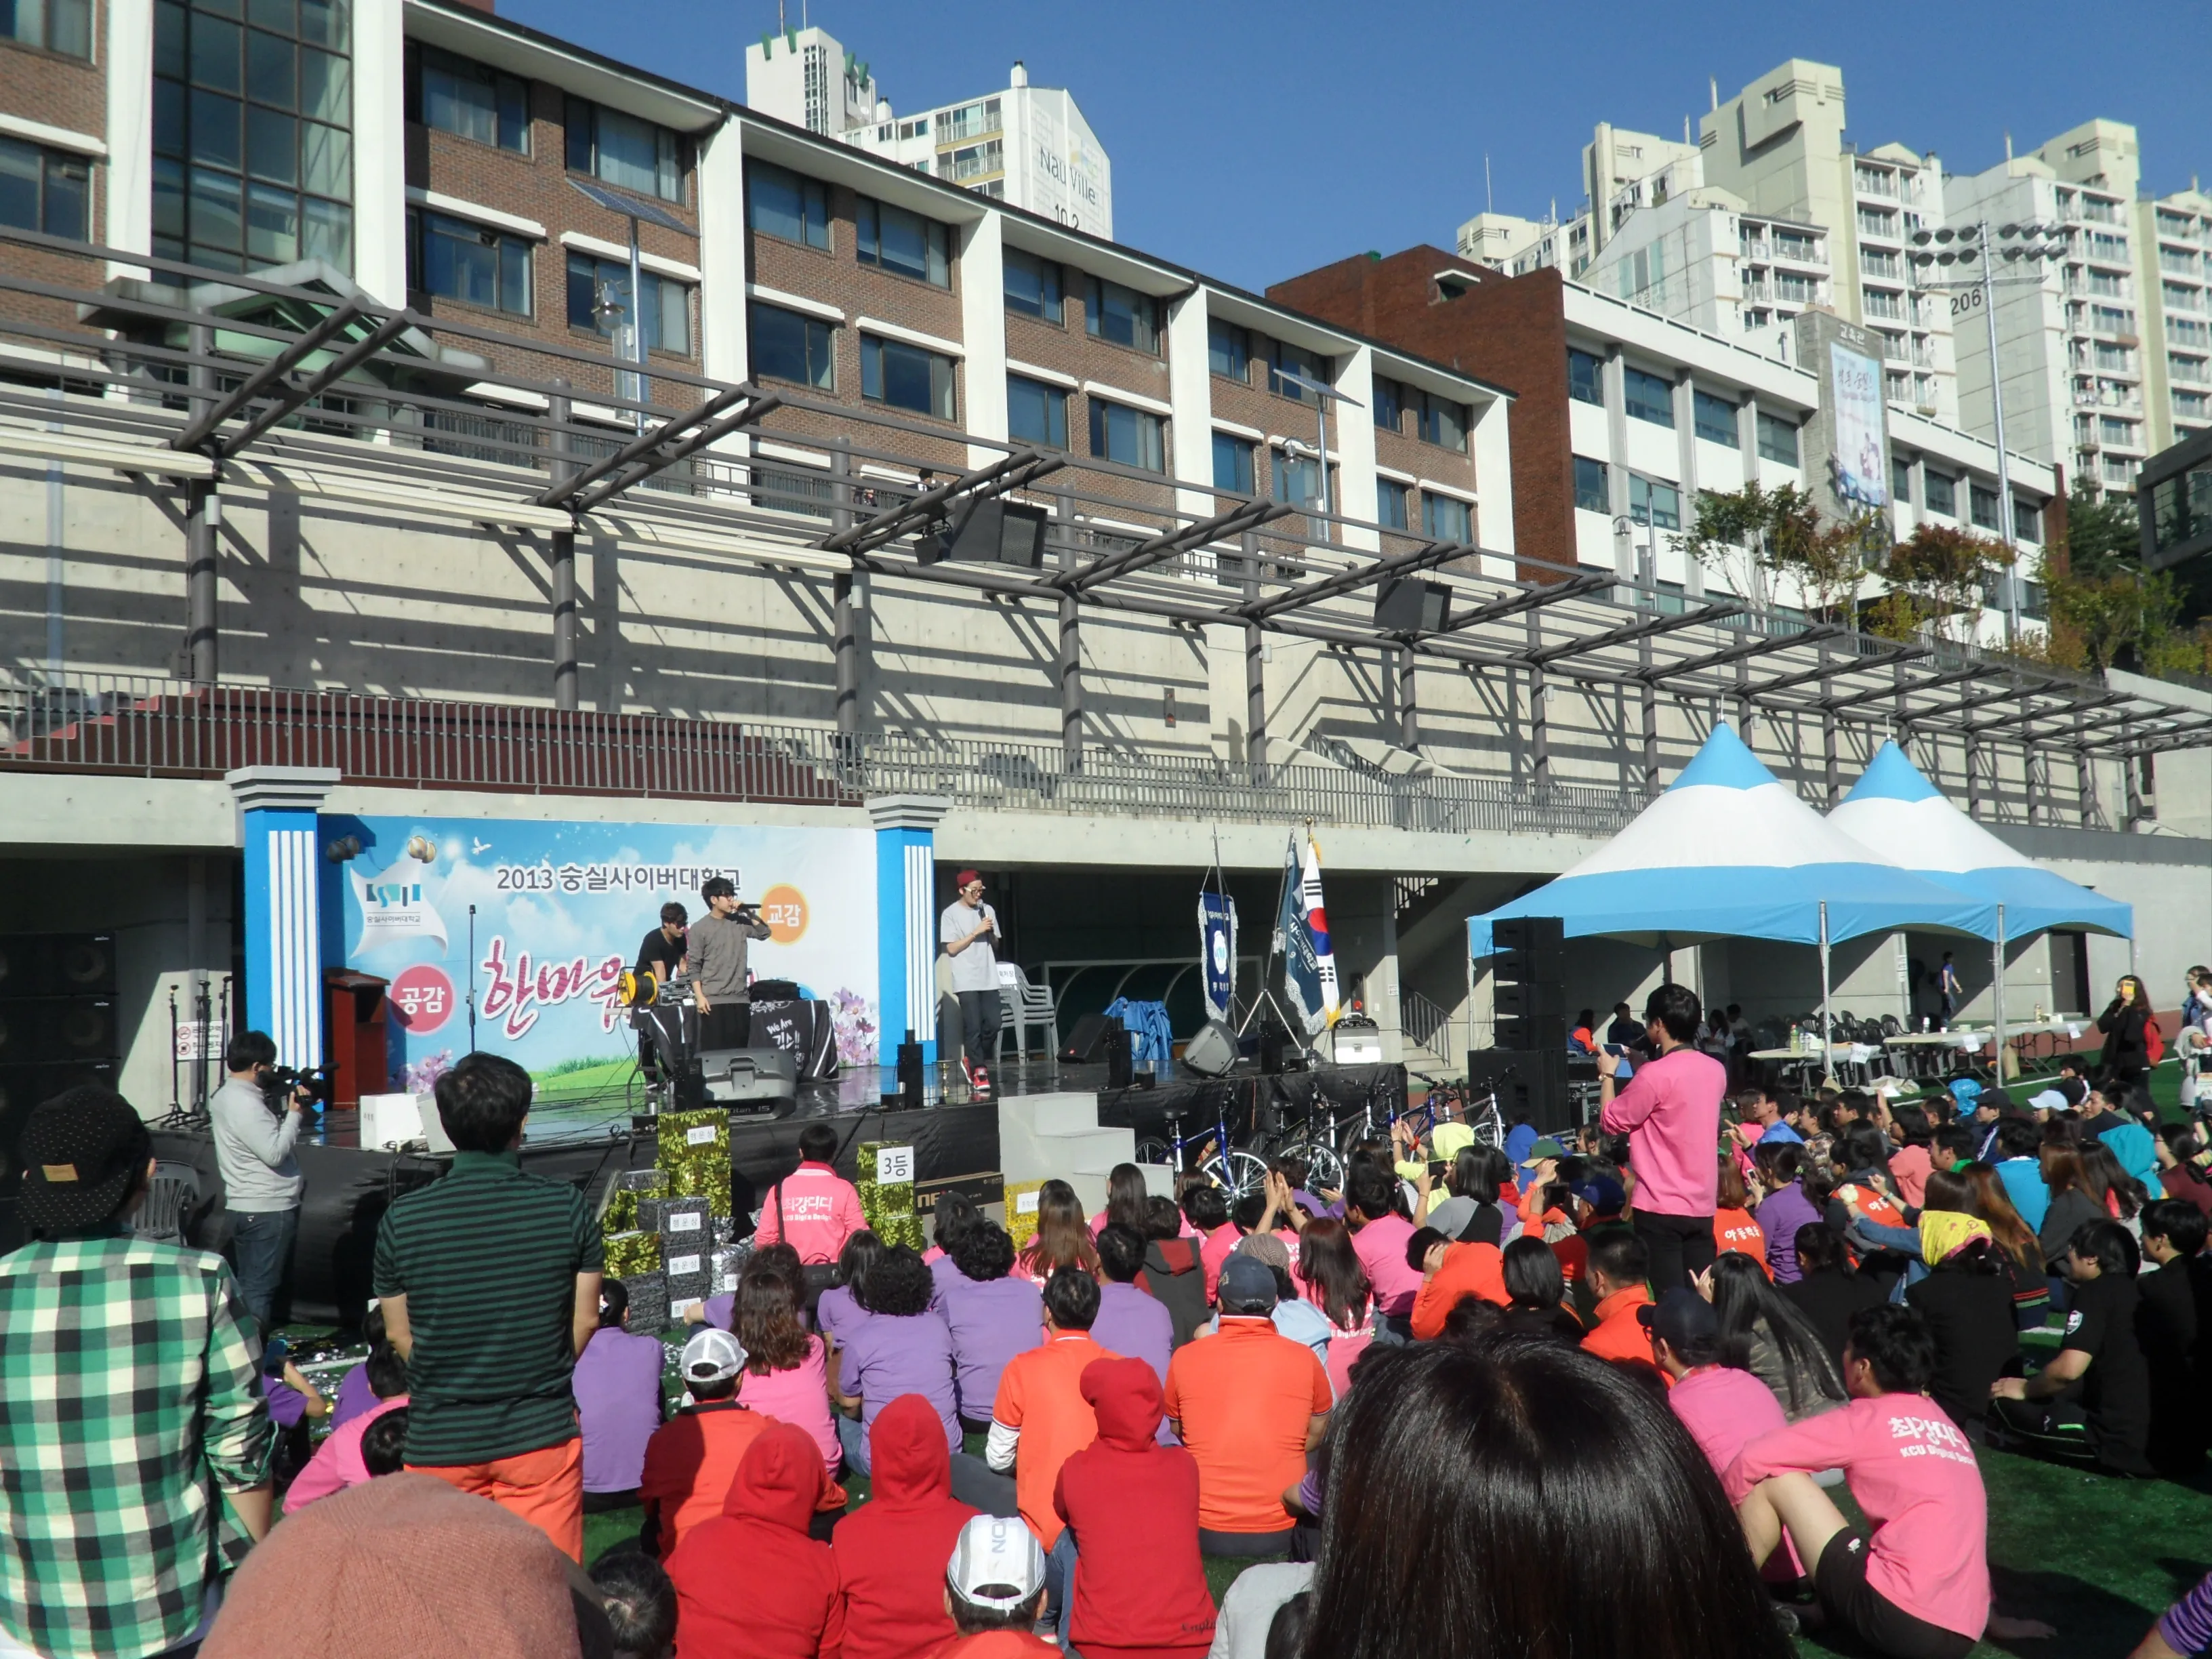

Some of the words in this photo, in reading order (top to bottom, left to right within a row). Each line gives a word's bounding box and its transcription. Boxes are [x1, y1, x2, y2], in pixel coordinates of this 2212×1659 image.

[1950, 289, 1982, 316] 206
[1840, 324, 1865, 345] 교육관
[497, 868, 553, 889] 2013
[560, 866, 741, 892] 숭실사이버대학교
[367, 915, 421, 924] 숭실사이버대학교
[766, 904, 801, 927] 교감
[398, 987, 445, 1013] 공감
[780, 1018, 793, 1030] Are
[884, 1154, 909, 1176] 3등
[782, 1195, 833, 1213] 최강디디
[1900, 1444, 1926, 1458] KCU
